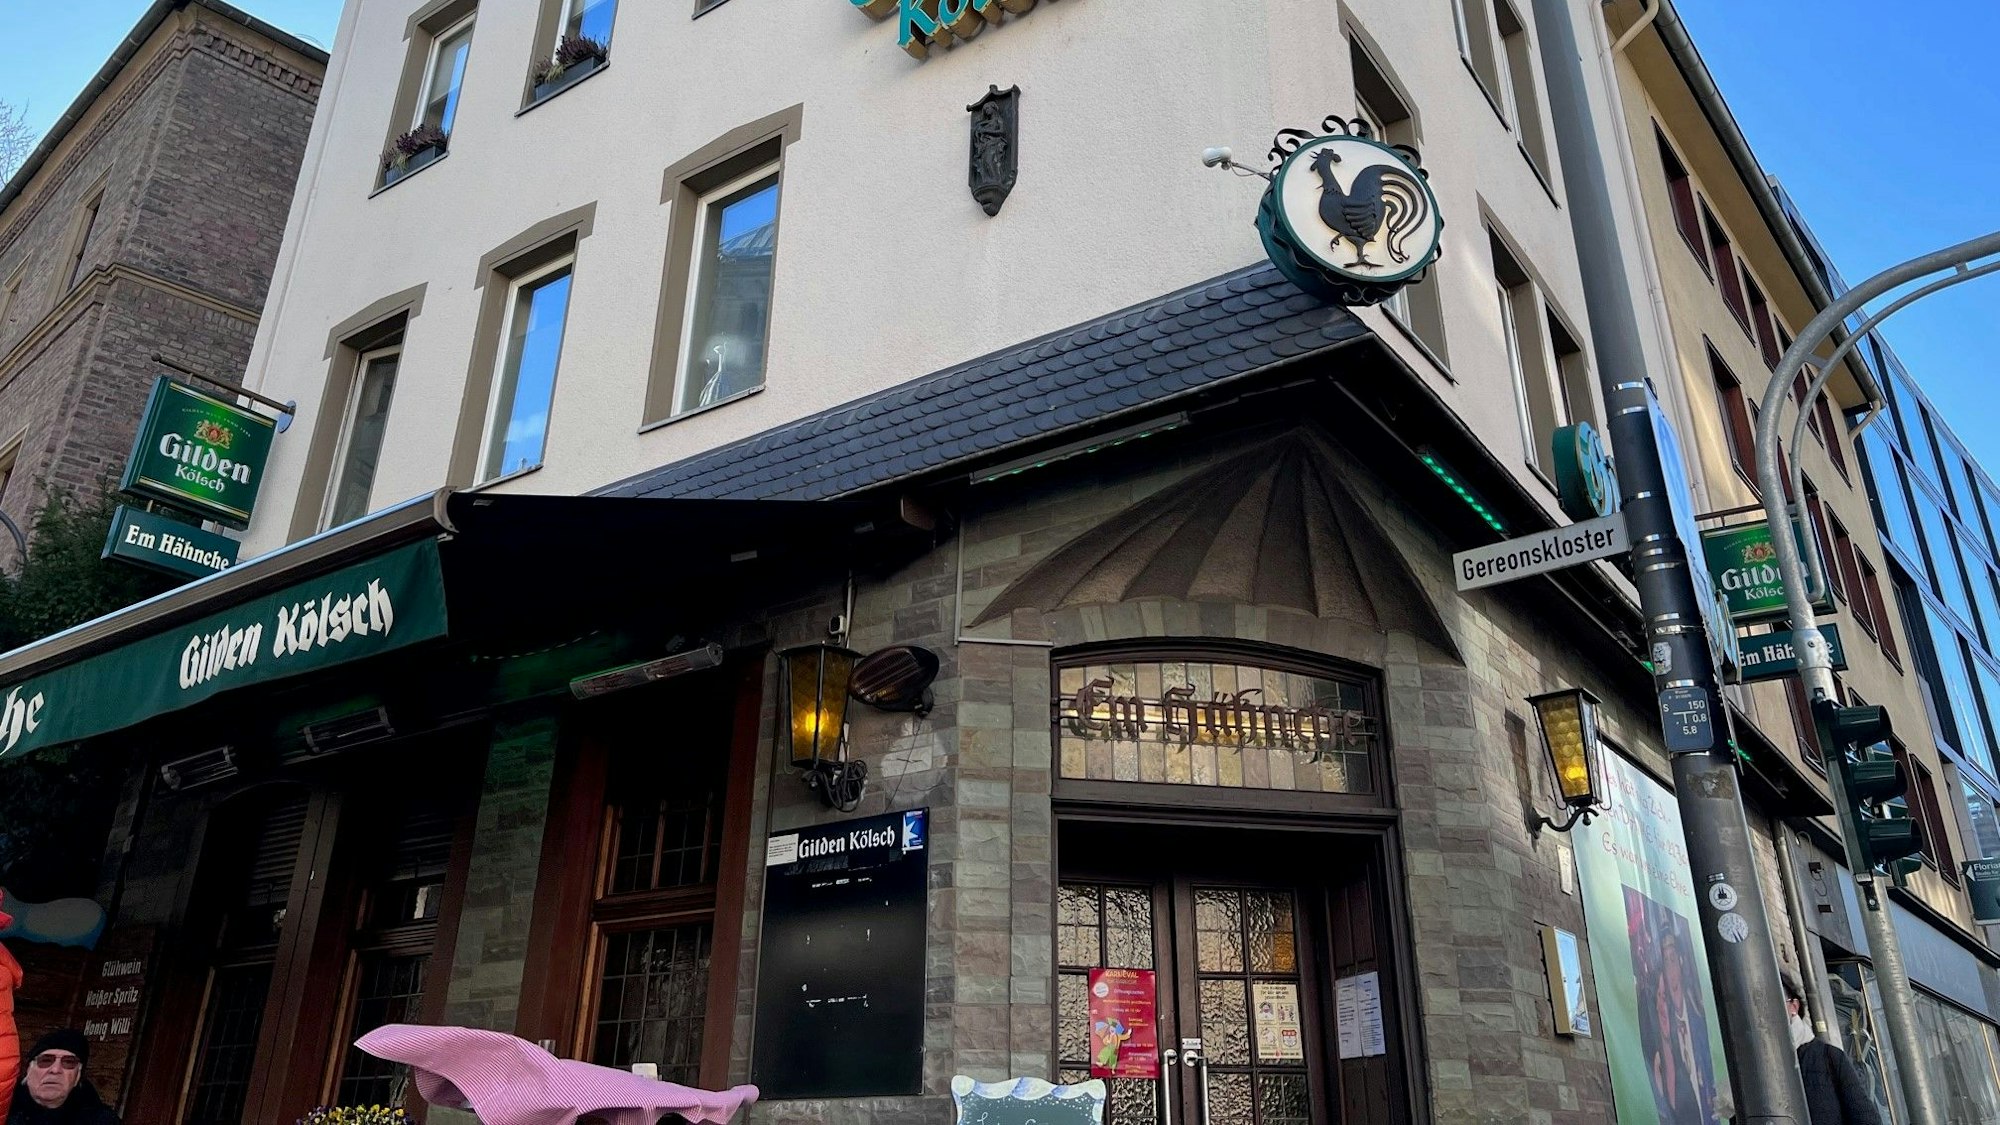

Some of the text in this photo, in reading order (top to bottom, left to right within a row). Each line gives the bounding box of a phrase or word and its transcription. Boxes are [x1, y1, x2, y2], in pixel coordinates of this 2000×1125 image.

[159, 432, 251, 484] Gilden
[174, 463, 226, 494] Kölsch
[125, 524, 230, 571] Em Hähnche
[1462, 528, 1614, 581] Gereonskloster
[1721, 561, 1809, 591] Gild
[1744, 586, 1785, 601] Kölsc
[178, 577, 394, 690] Gilden Kölsch
[1072, 675, 1149, 737] Em
[1662, 700, 1705, 712] S 150
[1692, 713, 1707, 723] 0.8
[1683, 726, 1698, 735] 5.8
[799, 835, 846, 859] Gilden
[850, 825, 896, 850] Kölsch
[102, 958, 141, 977] Glühwein
[85, 986, 139, 1008] Heißer Spritz
[84, 1017, 131, 1041] Honig Willi
